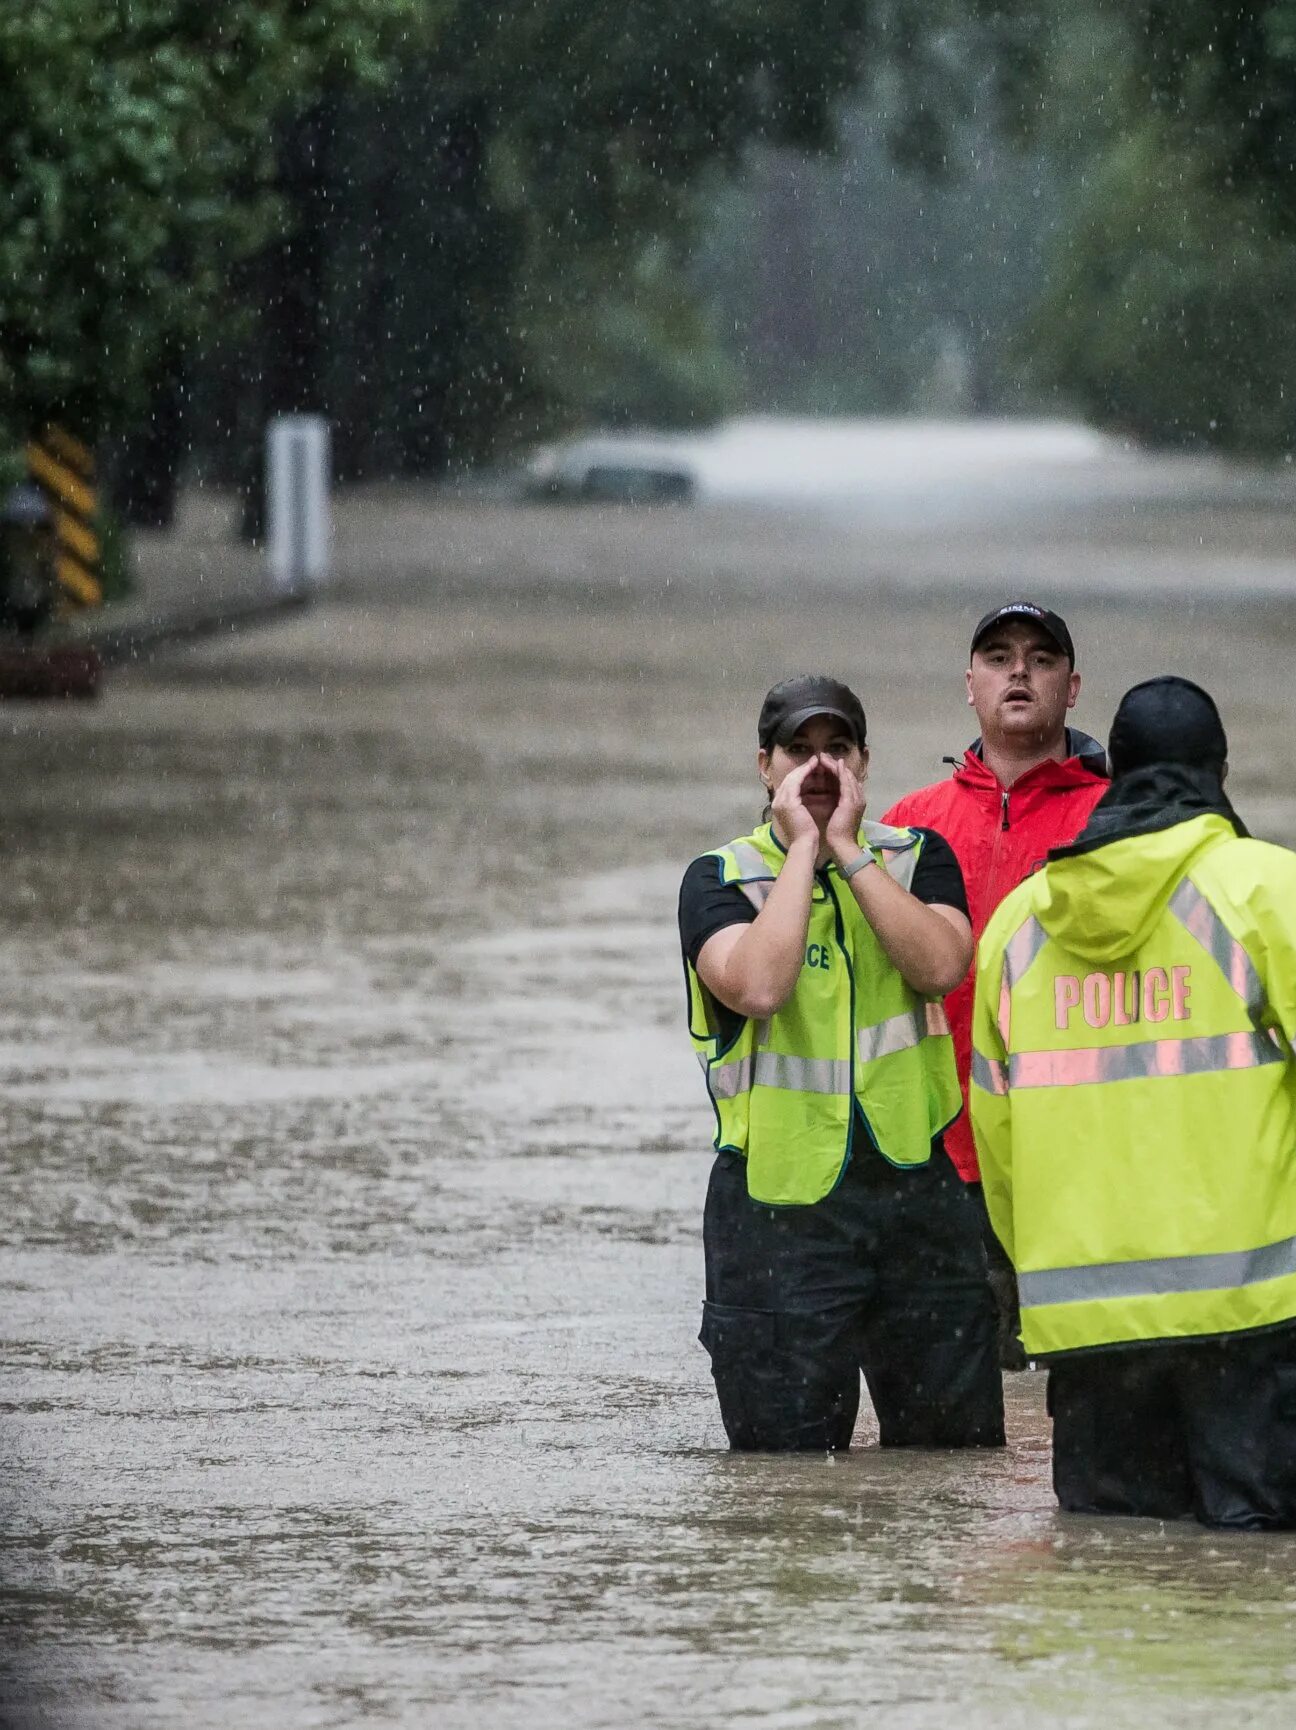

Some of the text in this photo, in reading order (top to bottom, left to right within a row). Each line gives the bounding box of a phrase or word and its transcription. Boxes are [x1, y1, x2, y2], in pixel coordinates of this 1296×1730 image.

[1000, 605, 1041, 616] SIMMS
[806, 943, 830, 970] CE
[1054, 965, 1192, 1030] POLICE
